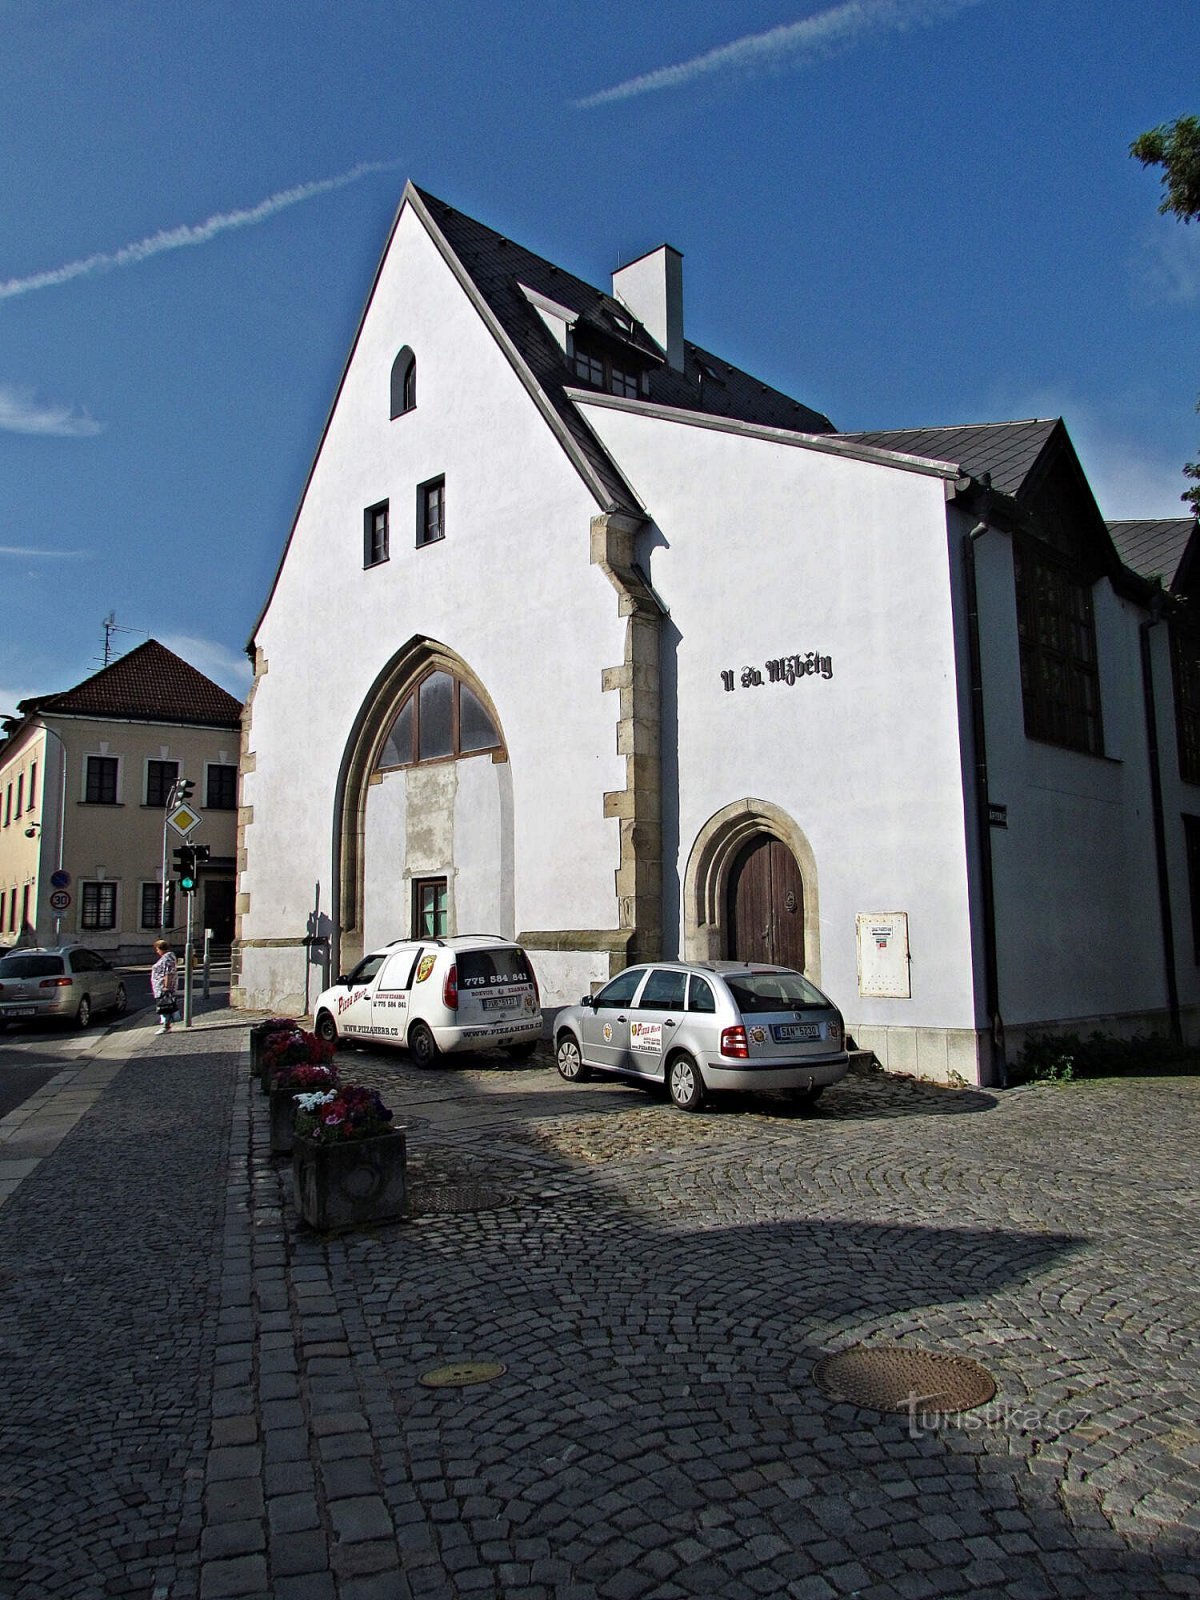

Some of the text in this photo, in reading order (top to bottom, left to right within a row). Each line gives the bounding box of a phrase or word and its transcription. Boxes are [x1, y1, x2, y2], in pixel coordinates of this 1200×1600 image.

[54, 895, 66, 905] 30
[464, 972, 528, 986] 775 584 841
